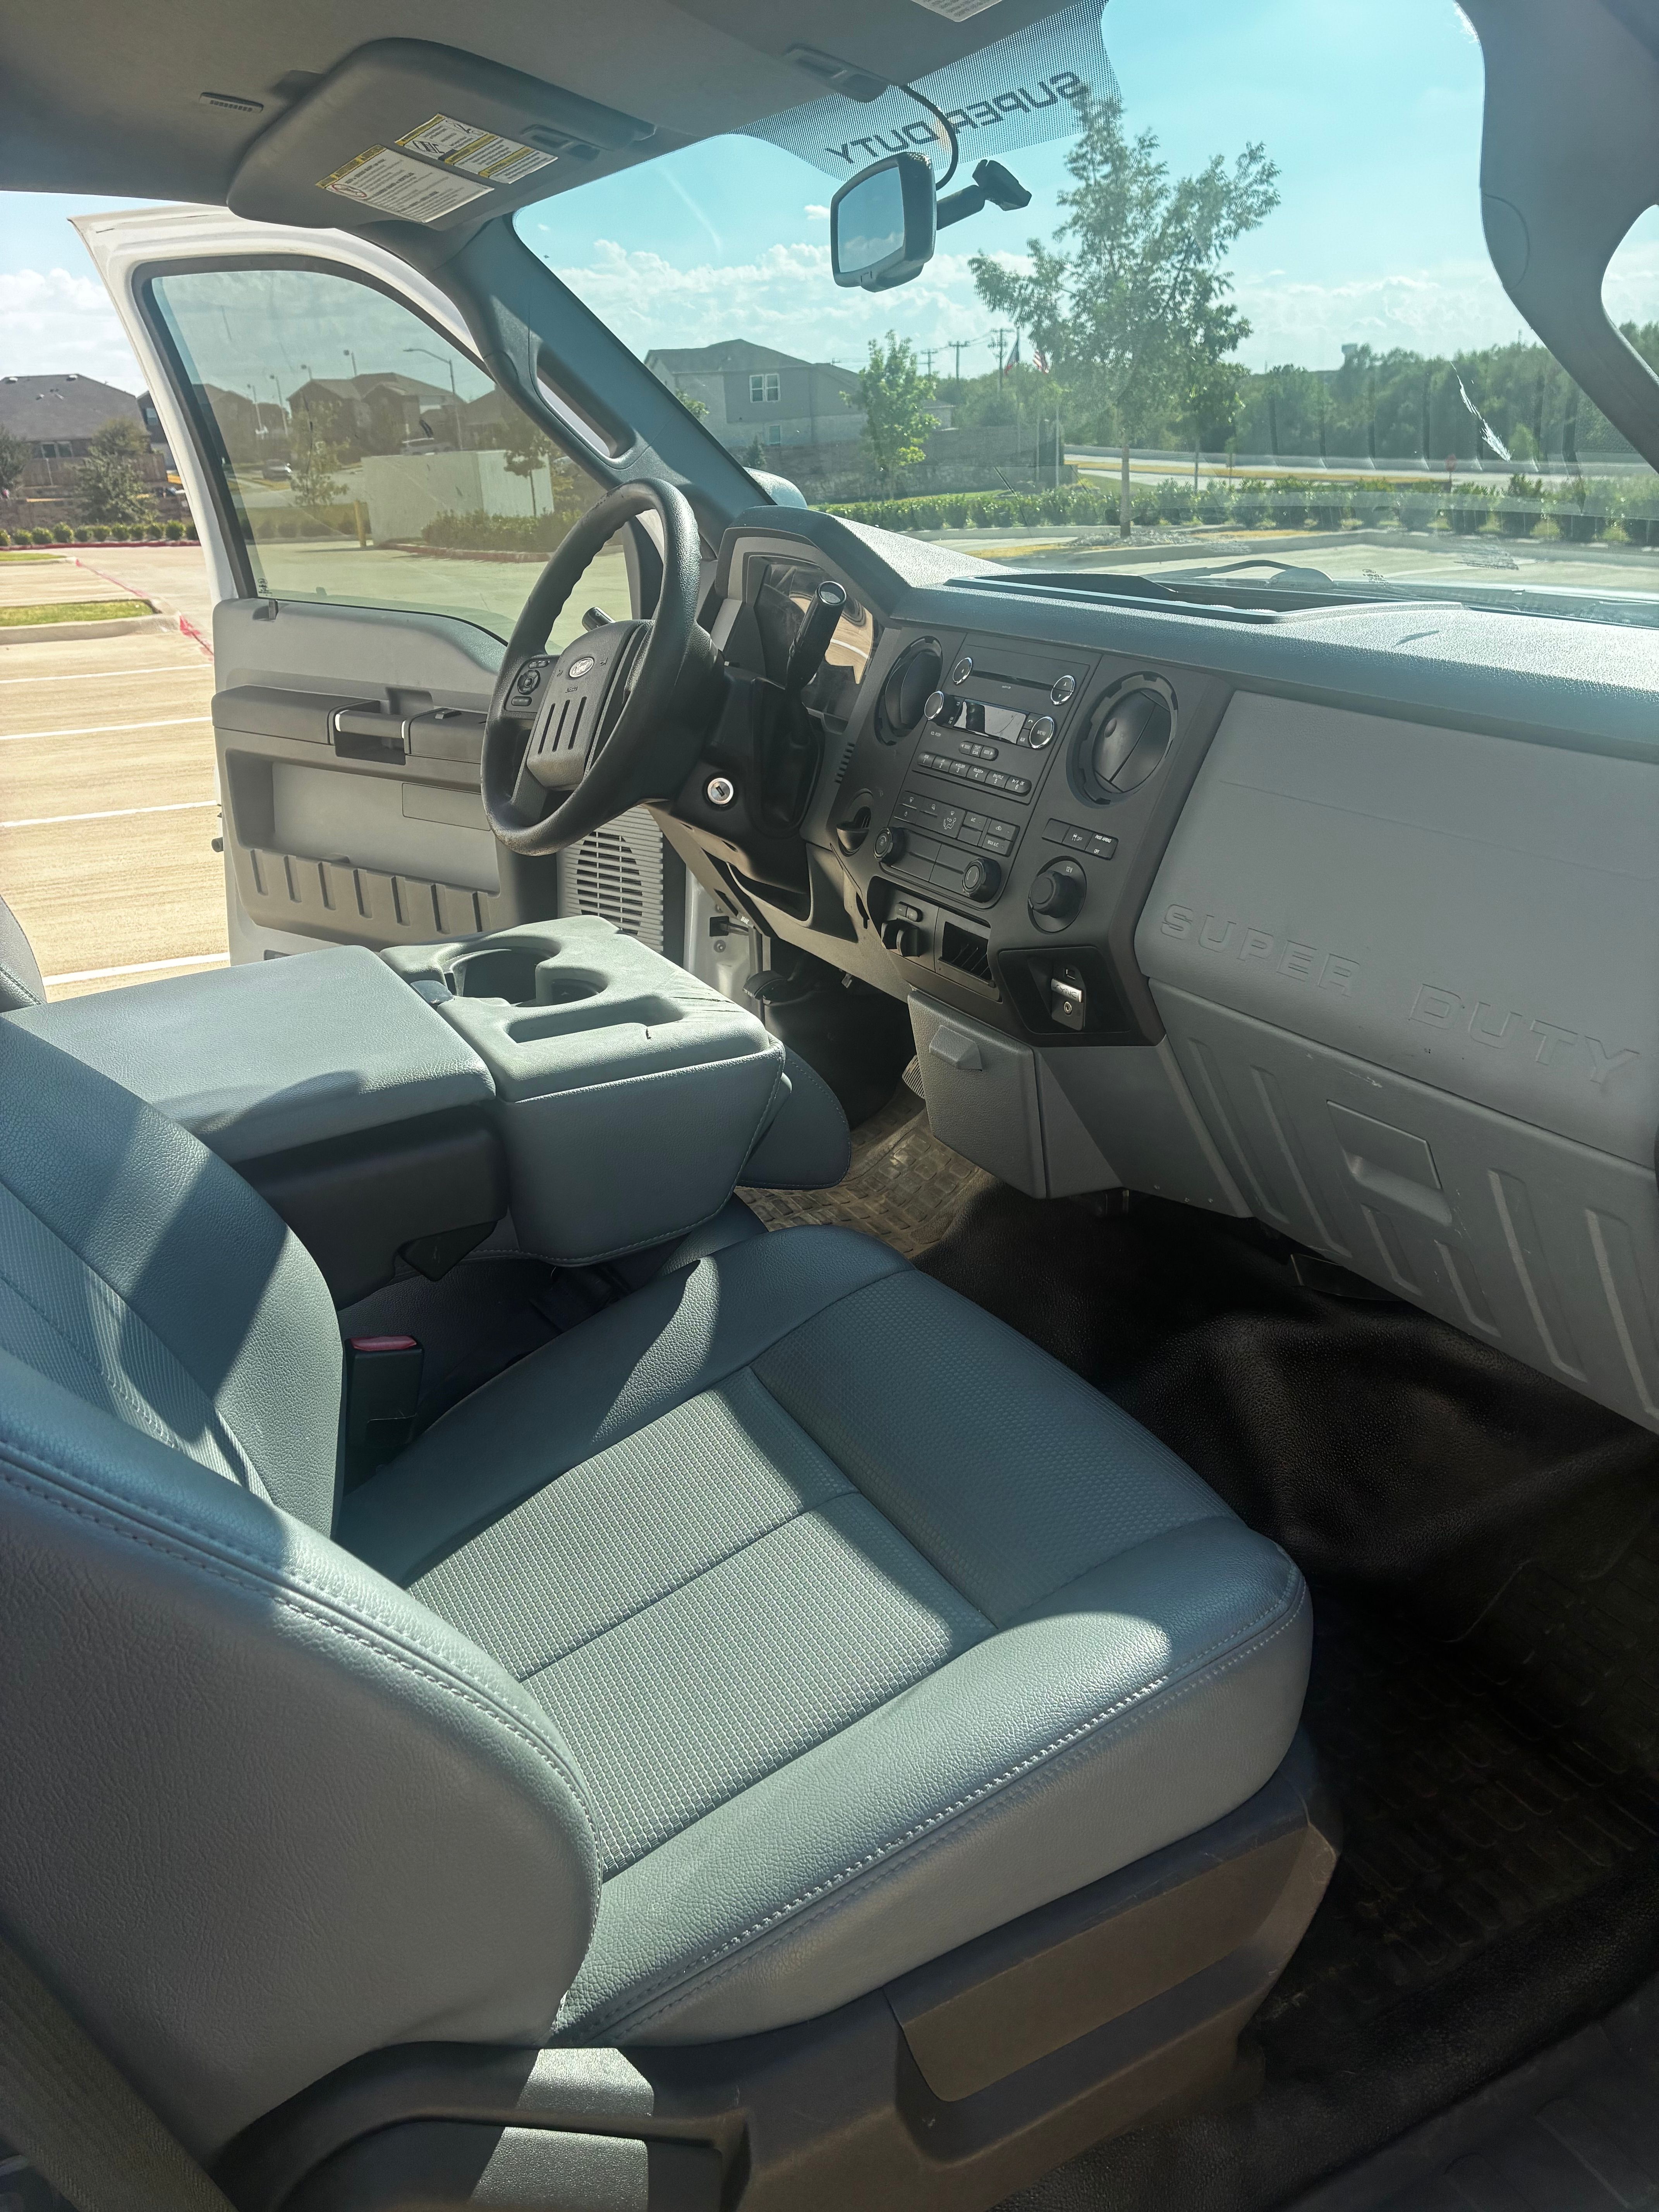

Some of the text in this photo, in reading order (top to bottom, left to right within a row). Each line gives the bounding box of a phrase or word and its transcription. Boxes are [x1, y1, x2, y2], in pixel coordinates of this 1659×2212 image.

[572, 659, 590, 674] Ford
[1053, 984, 1077, 998] SYNC
[1161, 904, 1640, 1084] SUPER DUTY
